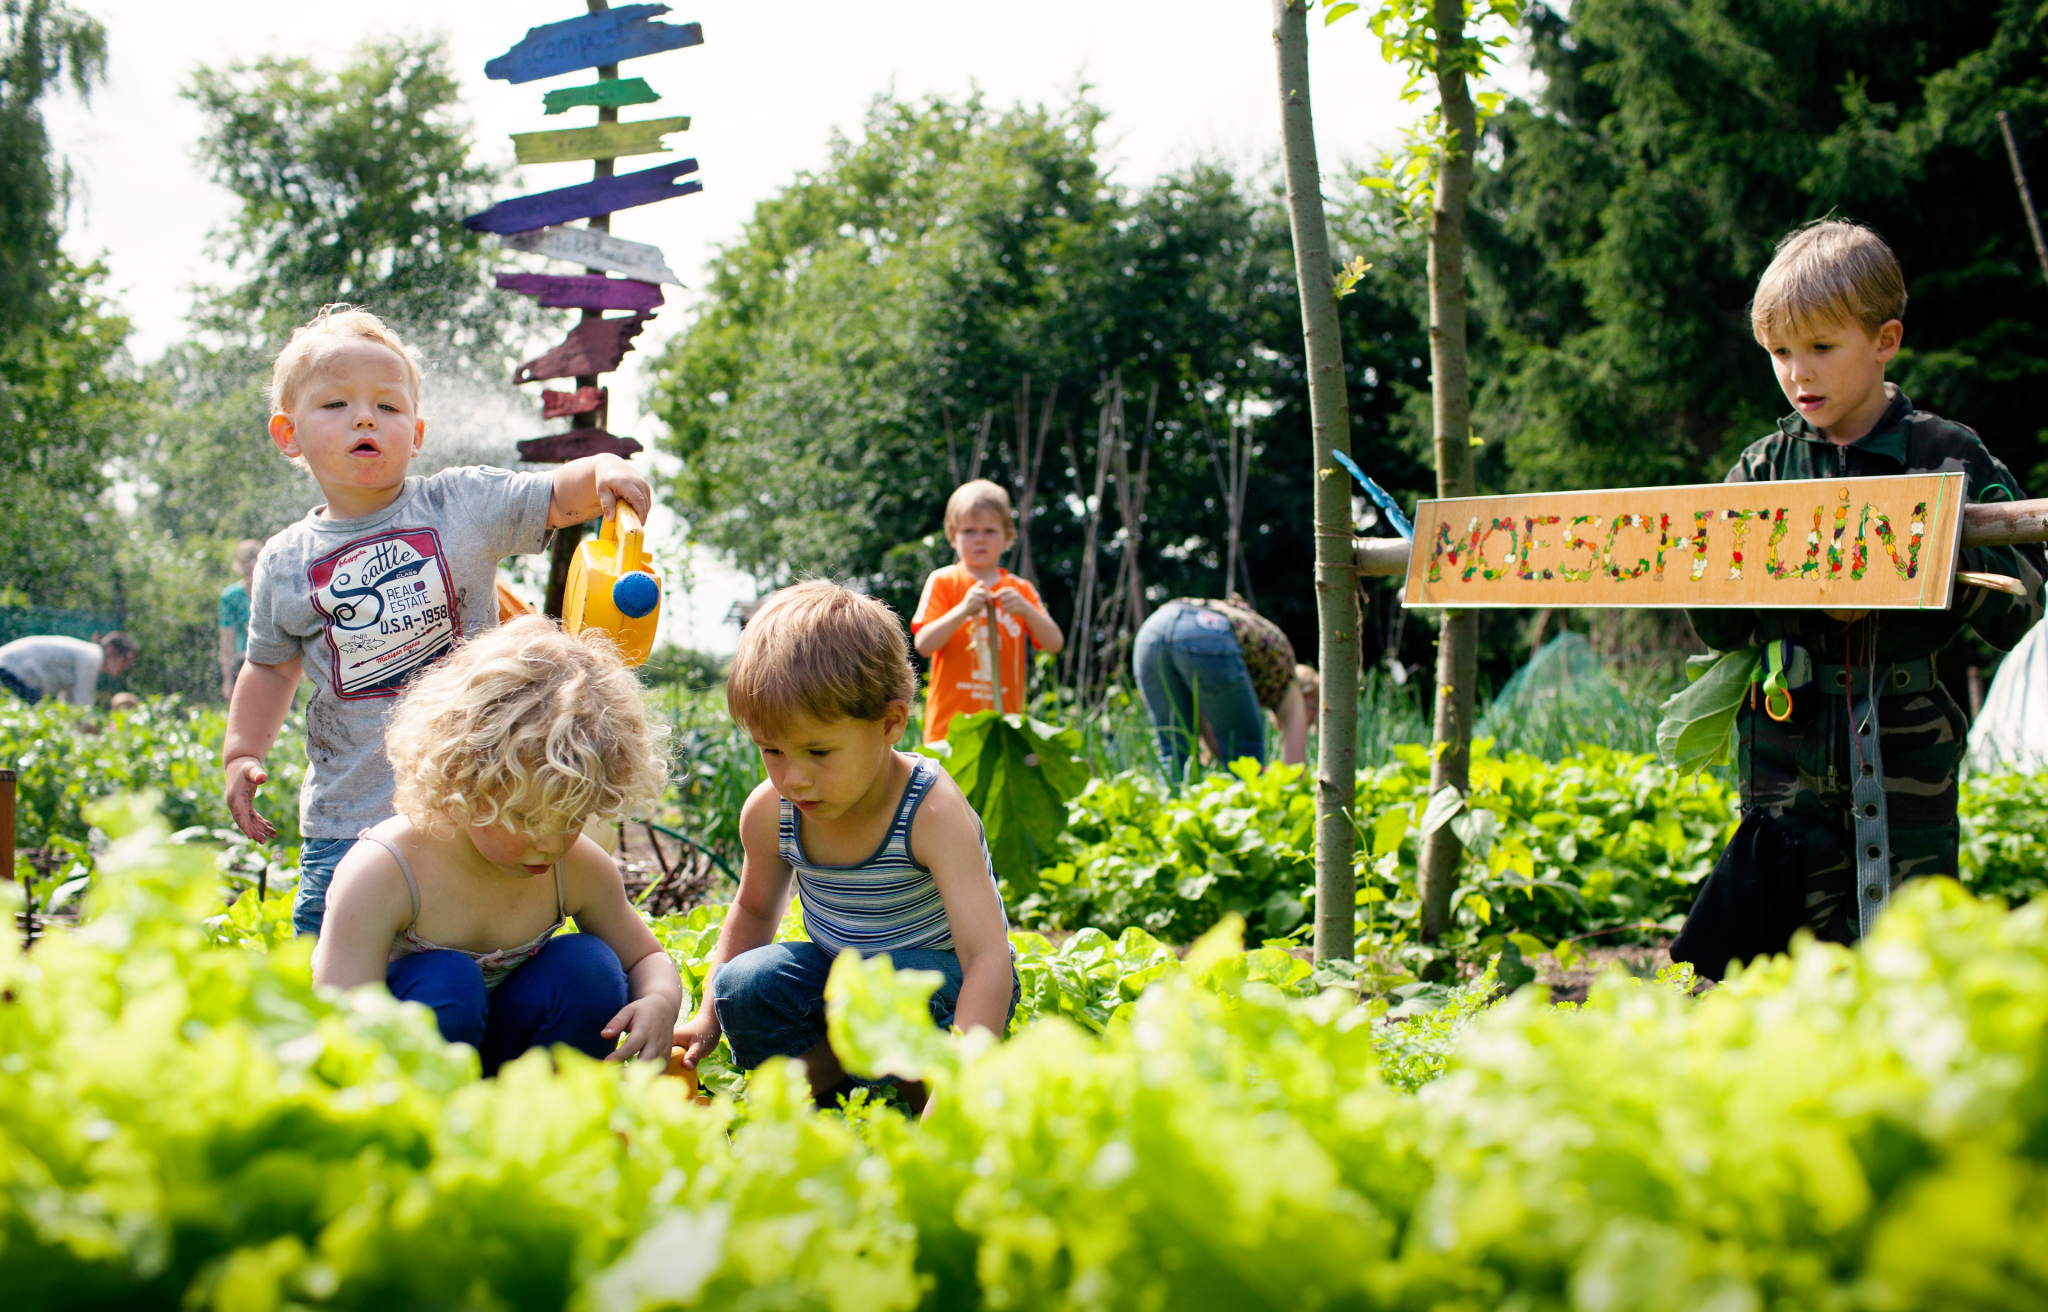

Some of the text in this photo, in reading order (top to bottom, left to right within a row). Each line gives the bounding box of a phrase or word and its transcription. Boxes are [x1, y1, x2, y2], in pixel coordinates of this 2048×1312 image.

[530, 19, 629, 62] compost
[1428, 487, 1926, 583] MOESCHTUIN
[330, 540, 417, 631] Seattle
[396, 570, 418, 580] CLASS
[386, 583, 415, 601] REAL
[389, 591, 431, 614] ESTATE
[376, 649, 403, 664] Michigan
